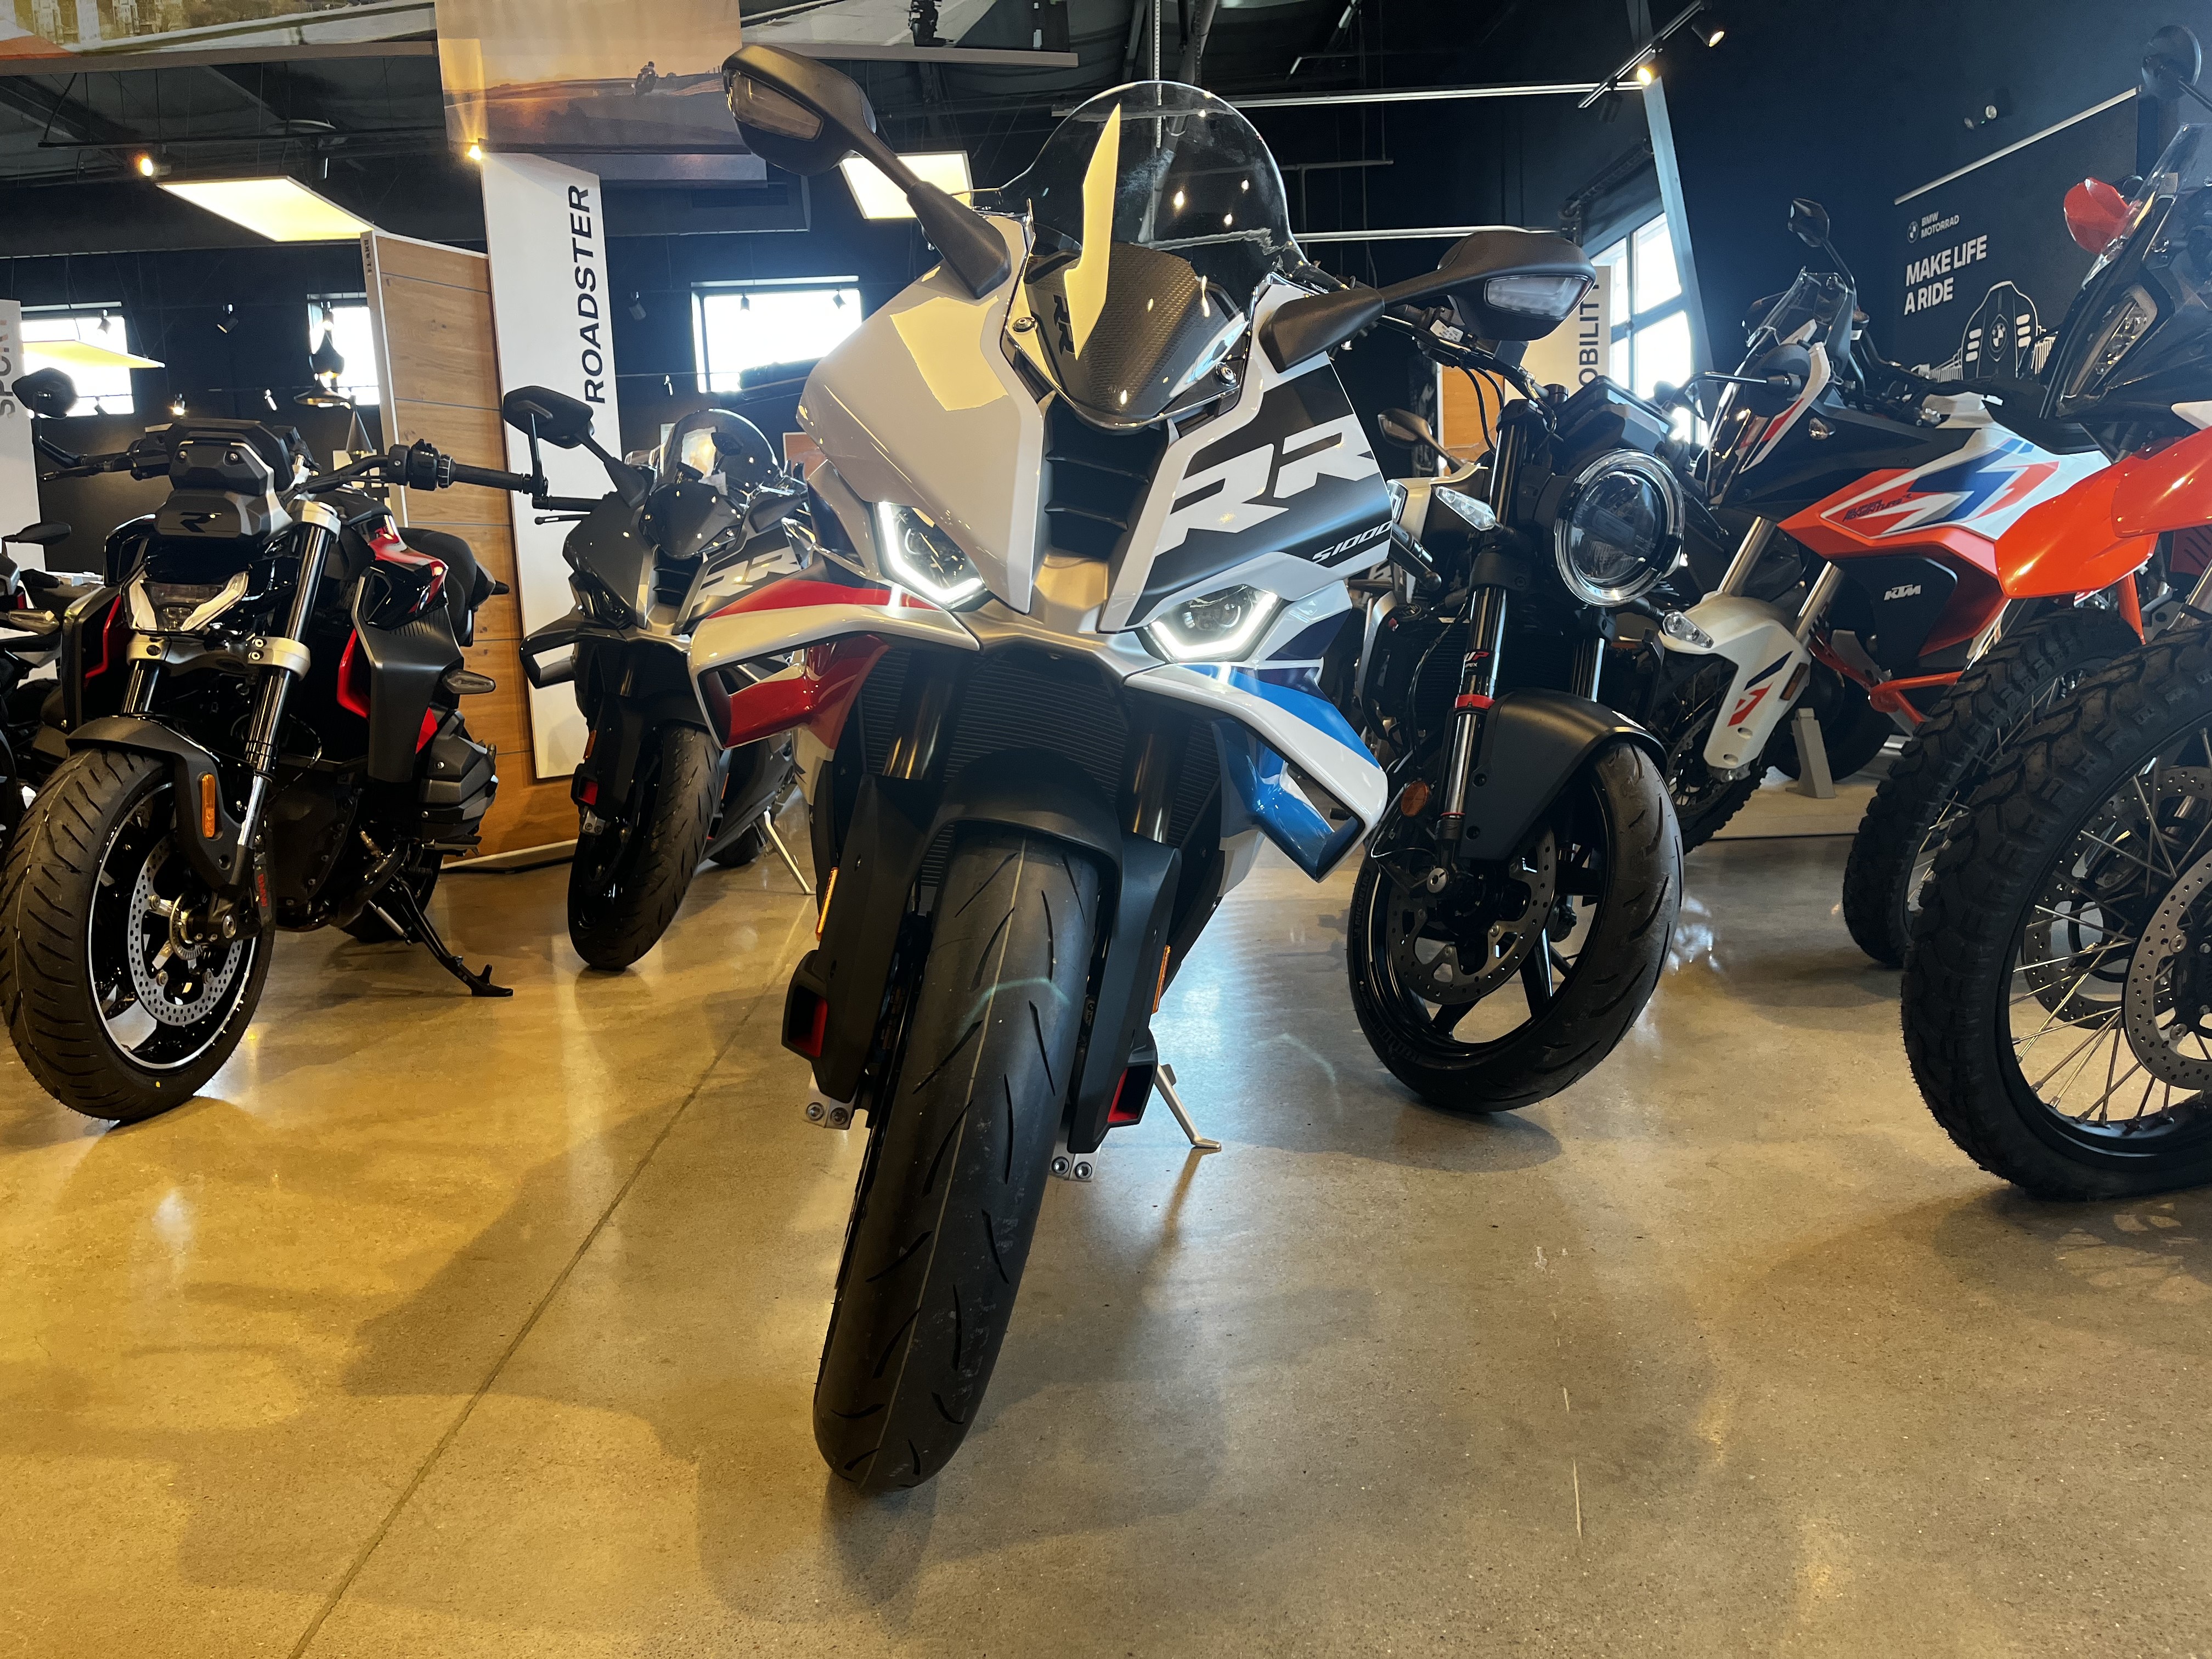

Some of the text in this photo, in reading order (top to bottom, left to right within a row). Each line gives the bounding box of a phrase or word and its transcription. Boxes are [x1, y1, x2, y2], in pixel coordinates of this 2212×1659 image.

[1921, 211, 1939, 227] BMW
[1921, 215, 1960, 239] MOTORRAD
[1906, 235, 1987, 287] MAKE LIFE
[568, 185, 605, 403] ROADSTER
[1904, 277, 1954, 315] A RIDE
[1579, 285, 1599, 386] OBILIT
[1312, 520, 1392, 563] S1000
[1884, 584, 1921, 600] KTM
